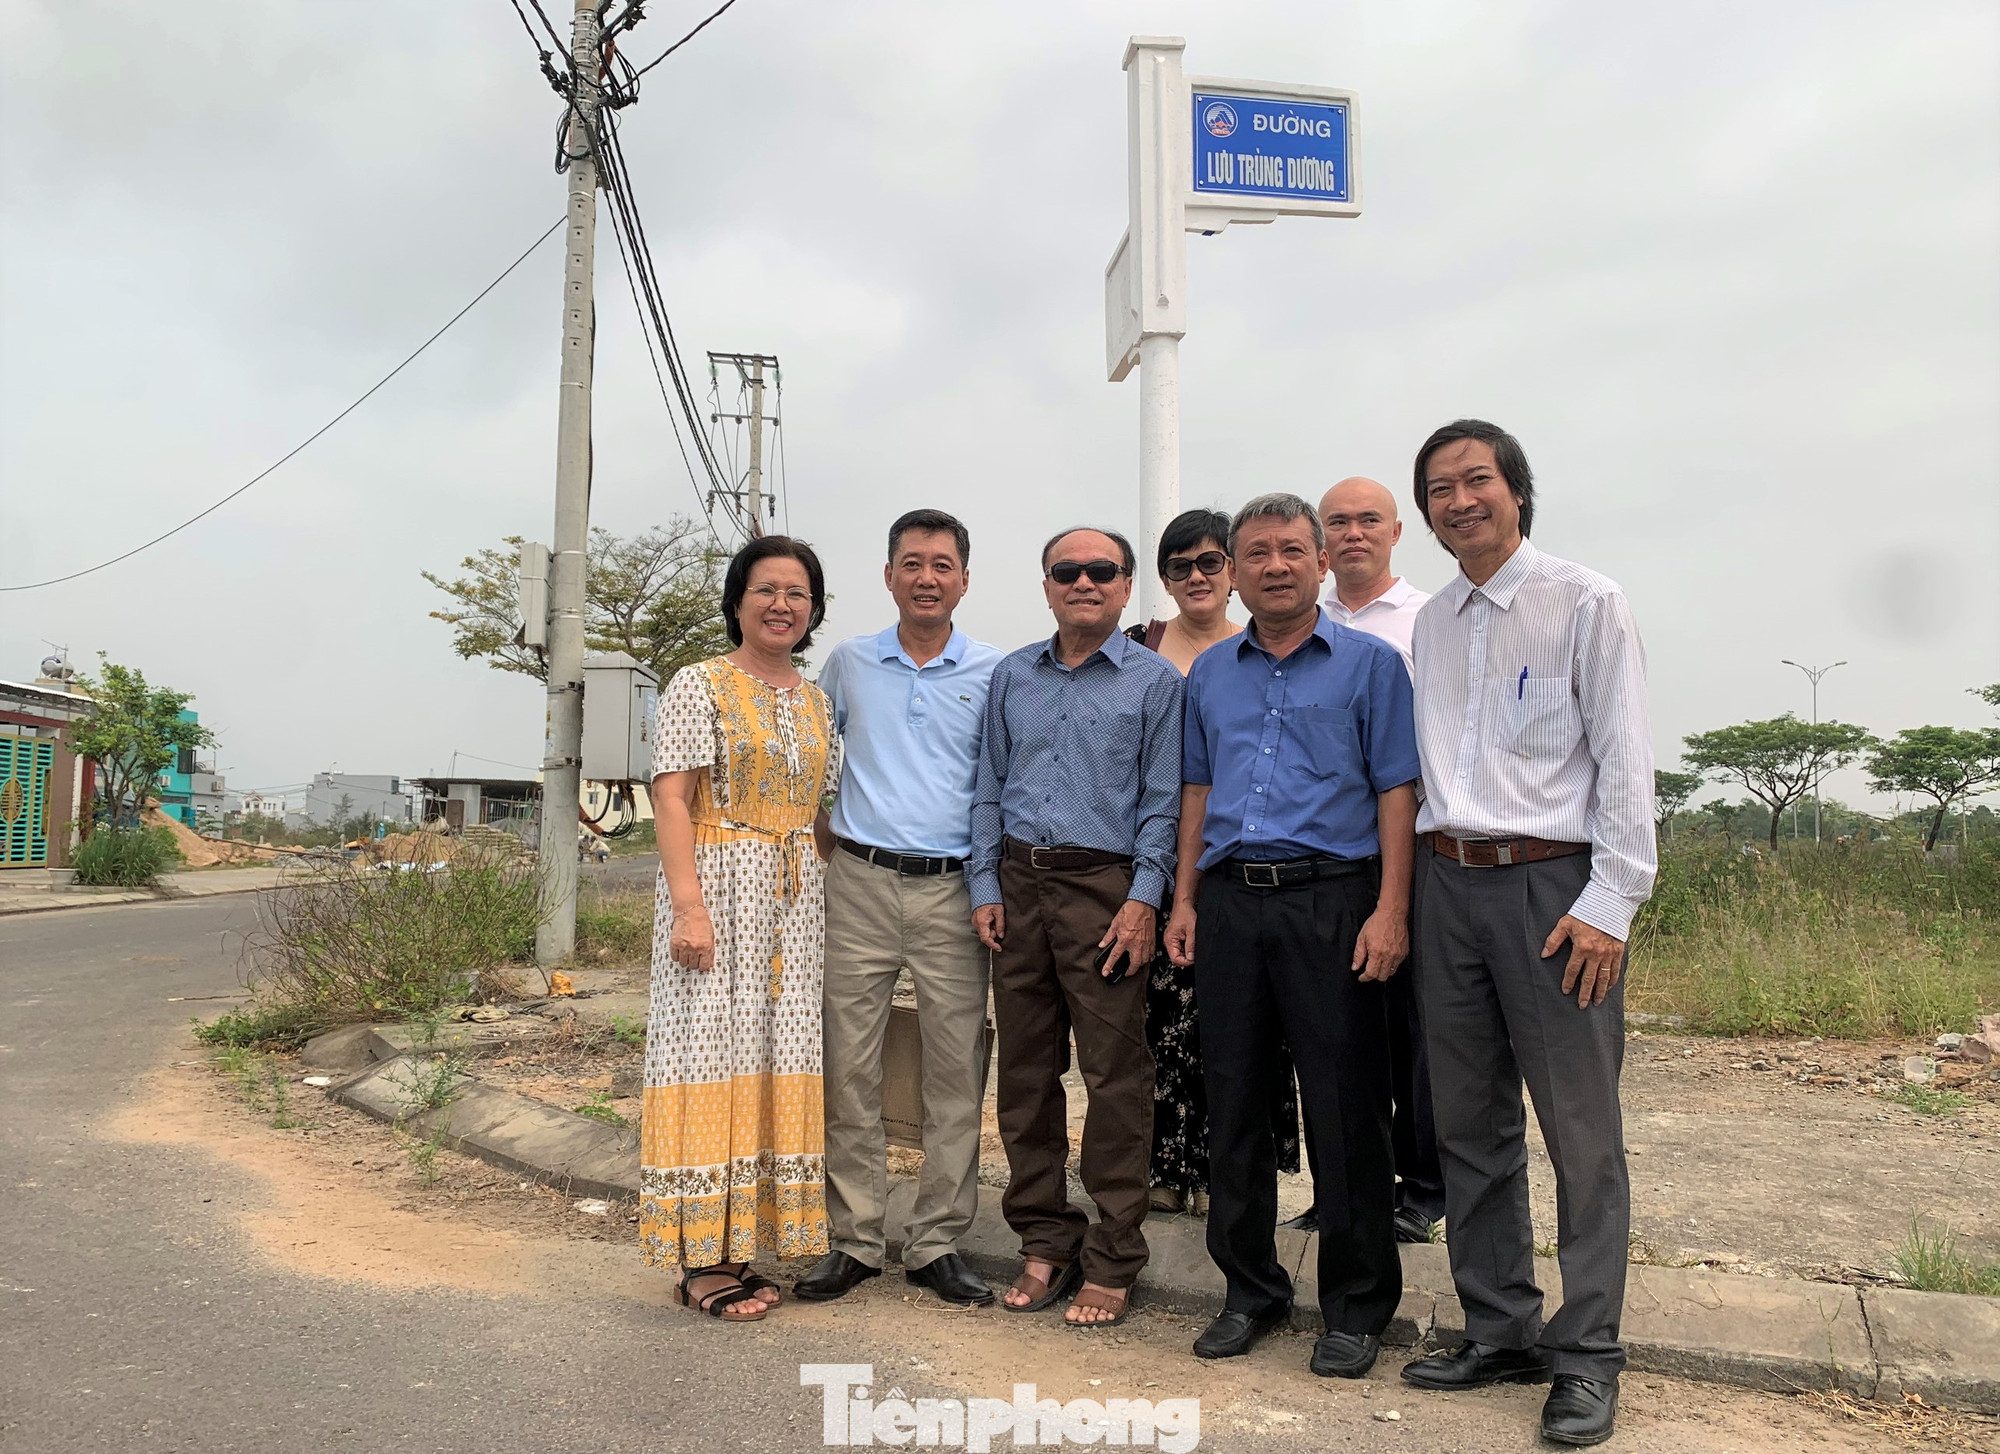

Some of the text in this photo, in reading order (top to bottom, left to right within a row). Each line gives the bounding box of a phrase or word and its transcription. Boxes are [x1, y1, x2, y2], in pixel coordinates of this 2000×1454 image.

[1253, 110, 1331, 138] ĐƯỜNG
[1207, 148, 1335, 191] LƯU TRÙNG DƯƠNG
